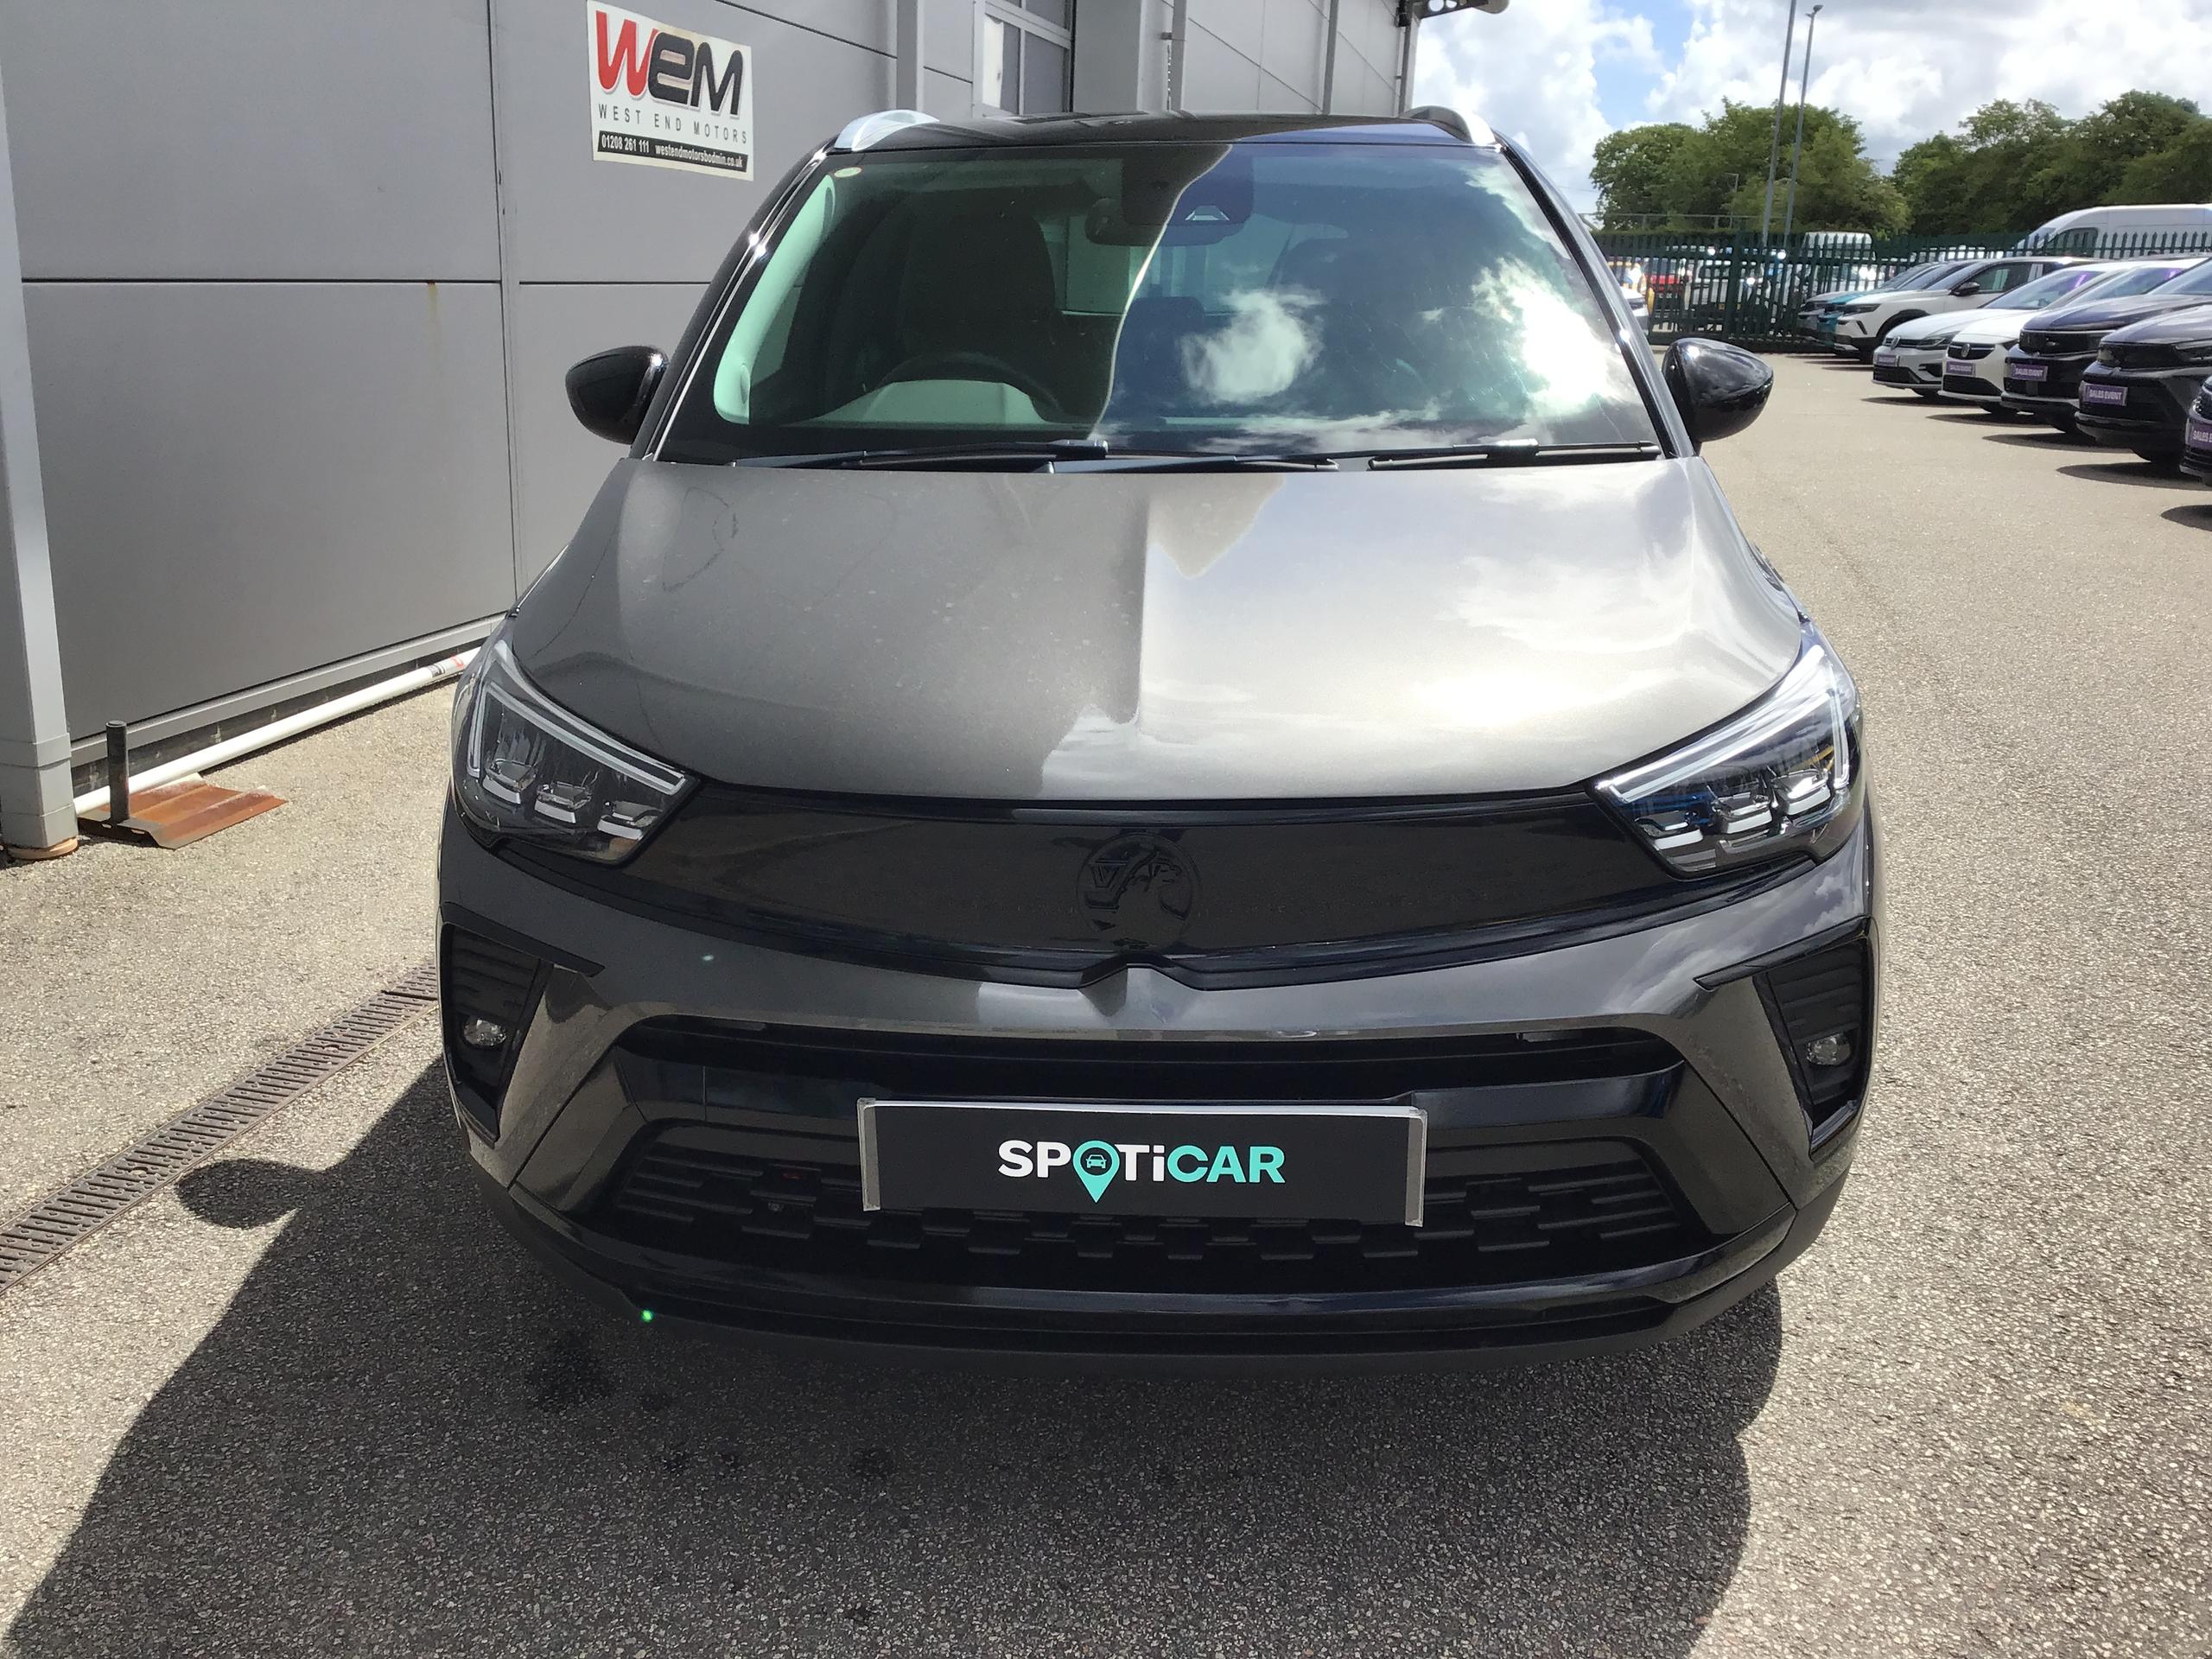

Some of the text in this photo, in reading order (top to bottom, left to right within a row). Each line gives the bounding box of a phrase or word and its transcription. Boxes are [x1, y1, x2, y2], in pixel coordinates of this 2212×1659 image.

[599, 104, 747, 144] WEST END MOTORS
[601, 134, 743, 168] 01208 261 111 westendmotorsbodmin.co.uk
[2089, 389, 2122, 400] SALES EVENT
